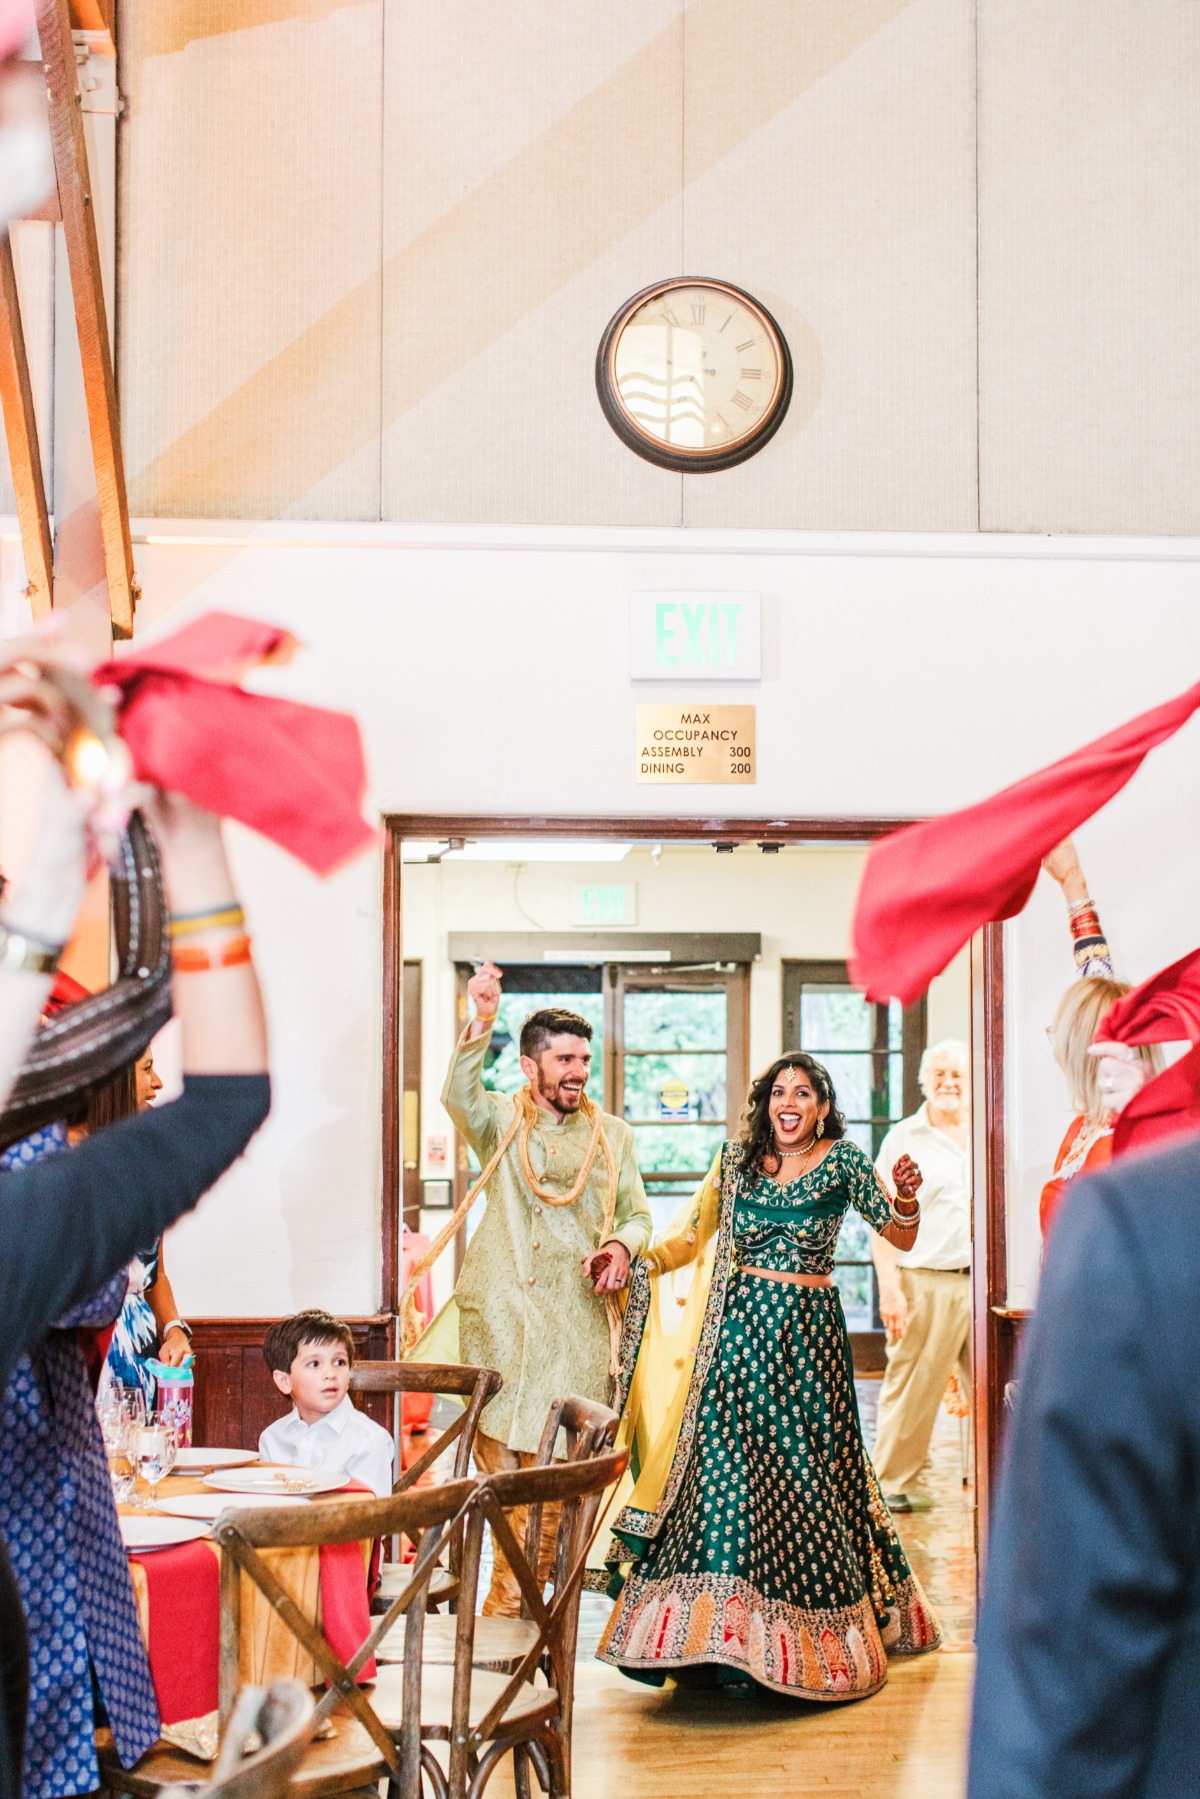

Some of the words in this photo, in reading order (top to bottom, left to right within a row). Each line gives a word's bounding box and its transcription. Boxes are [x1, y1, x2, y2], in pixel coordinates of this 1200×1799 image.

[660, 308, 681, 328] XI
[690, 304, 706, 326] XII
[735, 338, 756, 354] II
[740, 367, 762, 380] III
[655, 603, 743, 666] EXIT
[680, 713, 711, 724] MAX
[653, 729, 738, 741] OCCUPANCY
[641, 746, 704, 757] ASSEMBLY
[729, 746, 751, 757] 300
[641, 763, 685, 774] DINING
[730, 763, 751, 774] 200
[583, 886, 628, 920] EXIT
